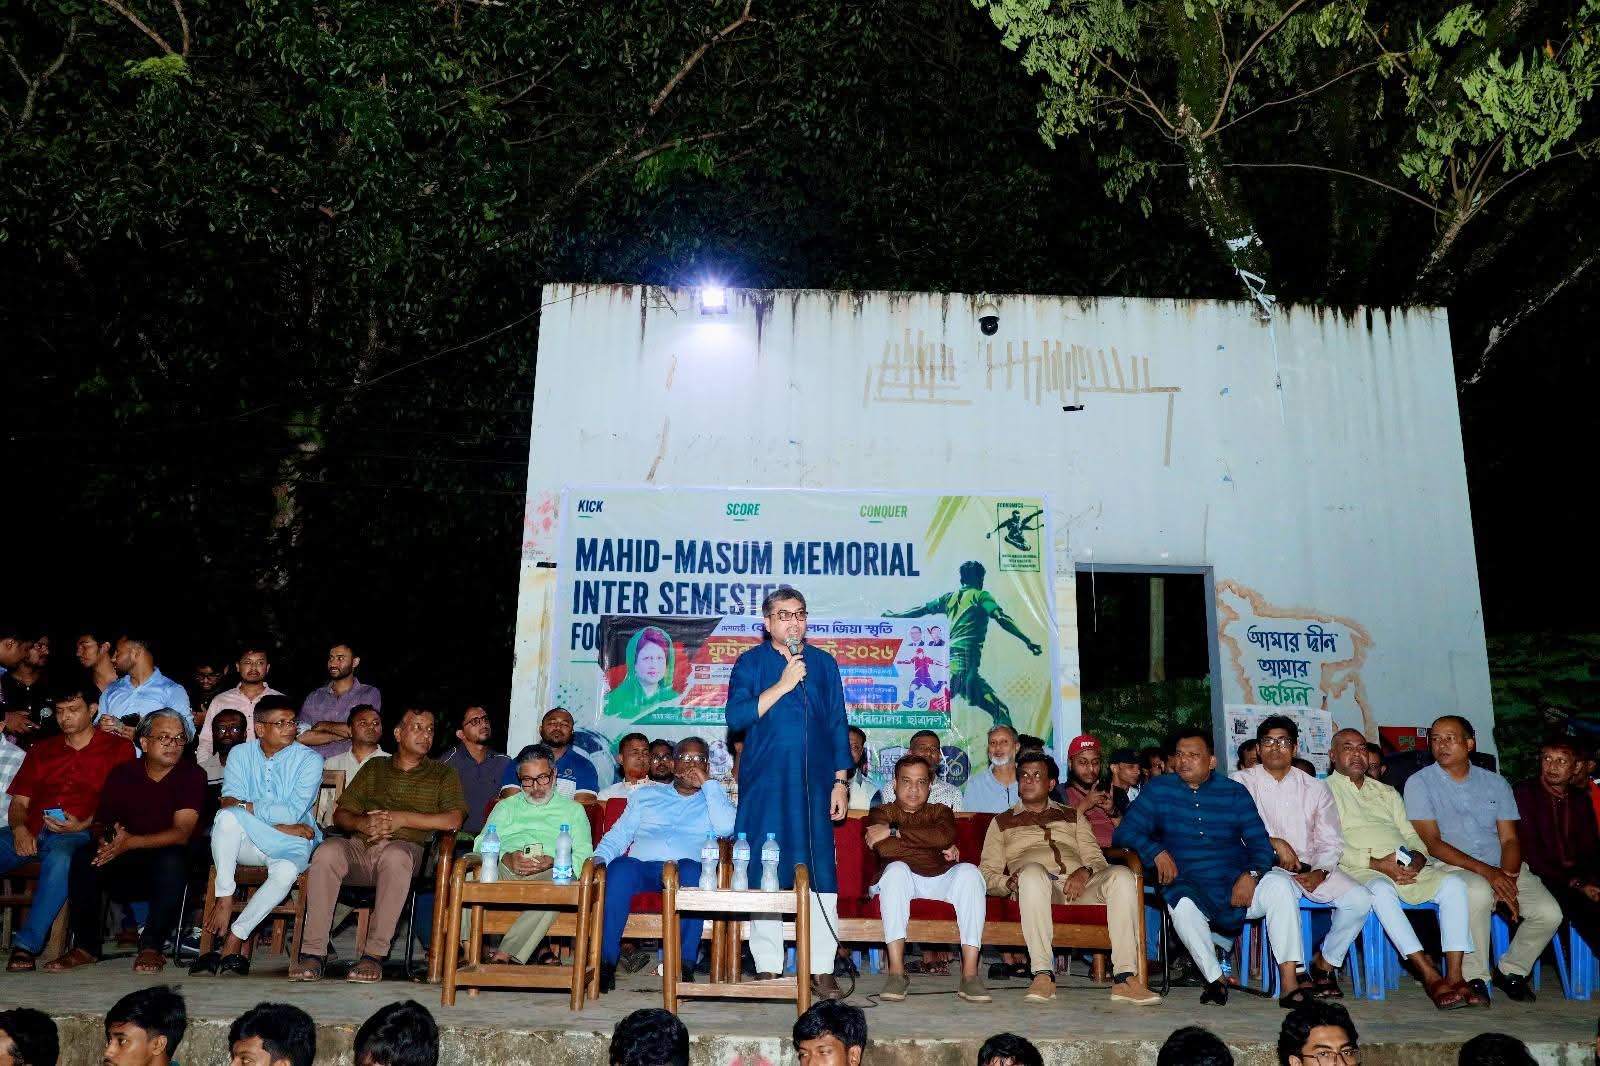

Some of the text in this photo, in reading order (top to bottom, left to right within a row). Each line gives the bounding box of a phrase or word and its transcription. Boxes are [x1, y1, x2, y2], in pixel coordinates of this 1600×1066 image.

[577, 499, 604, 513] KICK
[726, 503, 761, 516] SCORE
[859, 504, 908, 519] CONQUER
[575, 537, 921, 577] MAHID-MASUM MEMORIAL
[572, 580, 649, 615] INTER
[1247, 624, 1339, 653] আমার দ্বীন
[1257, 658, 1312, 680] আমার
[1258, 678, 1315, 706] জমিন
